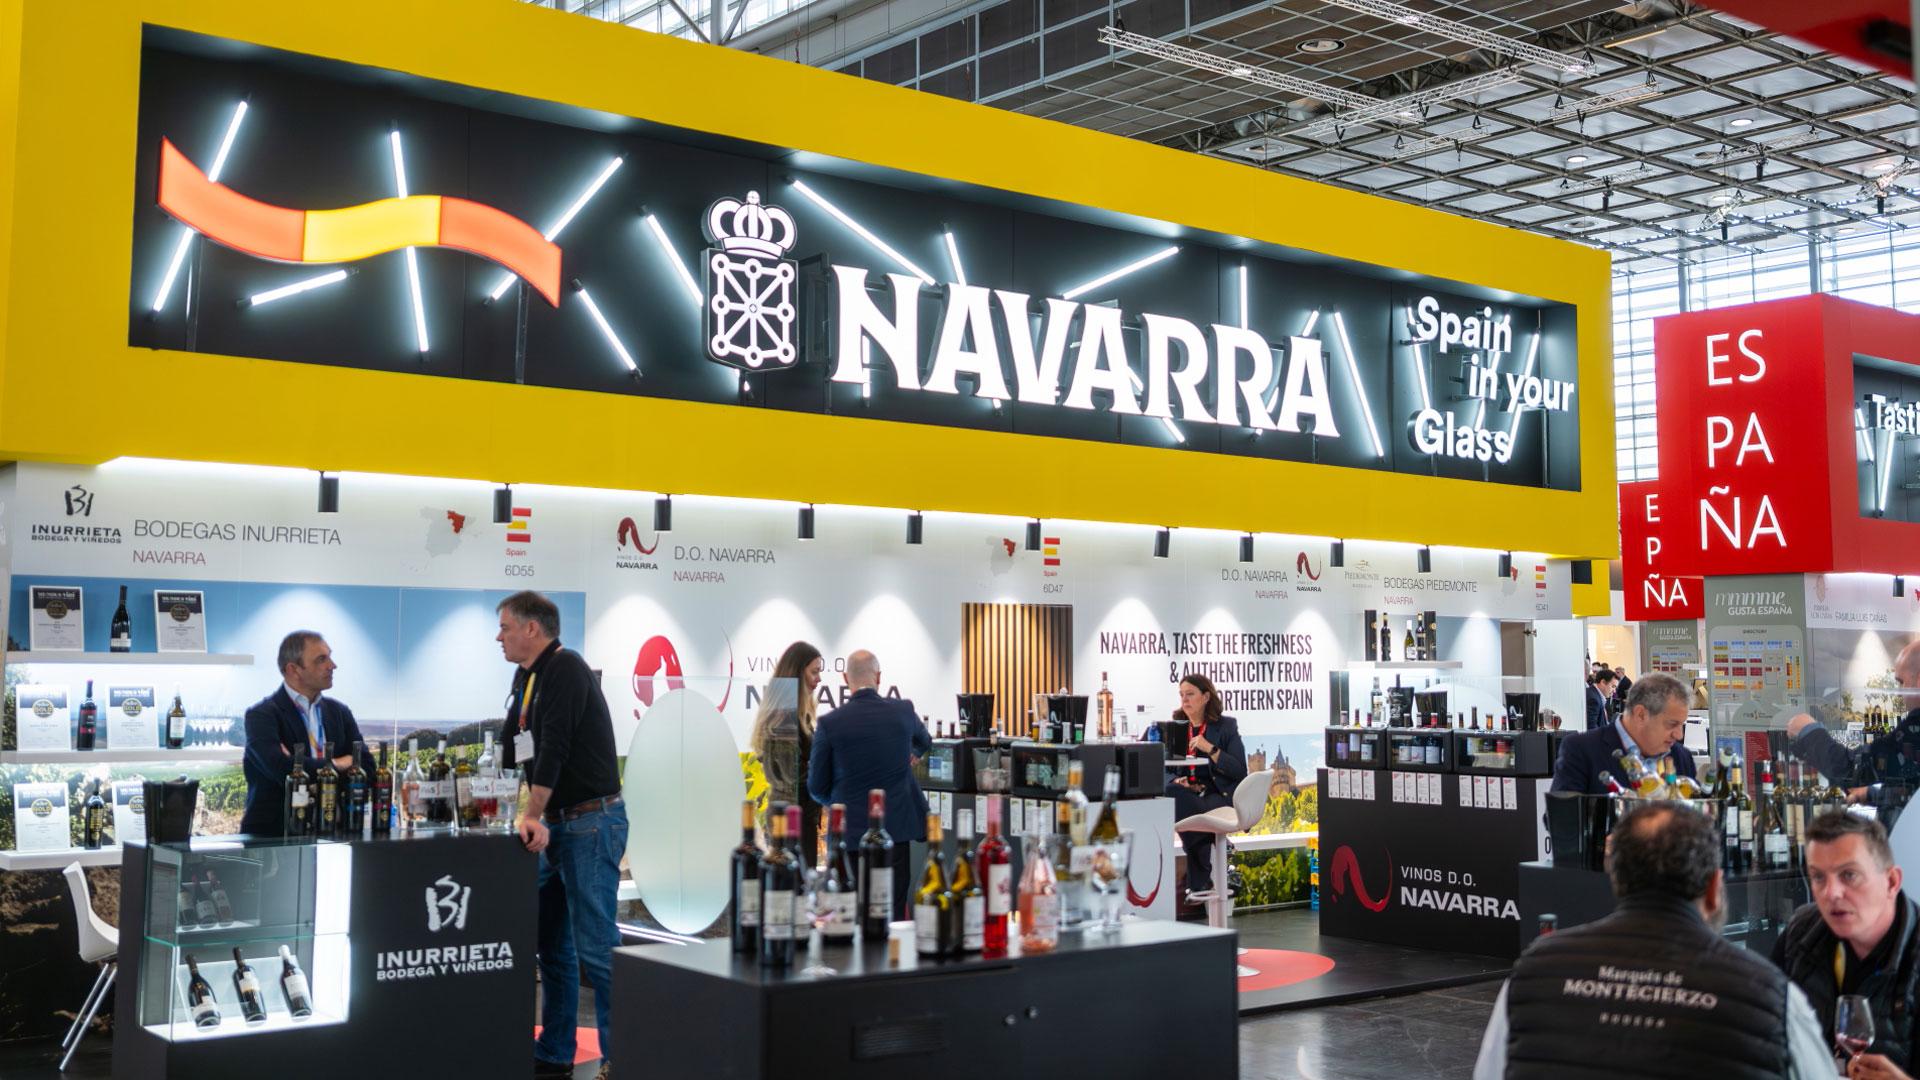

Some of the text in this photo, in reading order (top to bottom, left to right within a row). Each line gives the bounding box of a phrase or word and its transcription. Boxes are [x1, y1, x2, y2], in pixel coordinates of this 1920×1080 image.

[1416, 295, 1512, 354] Spain
[830, 264, 1340, 438] NAVARRA
[1706, 329, 1767, 386] ES
[1469, 353, 1575, 413] in your
[1414, 408, 1511, 463] Glass
[1706, 412, 1774, 468] PA
[1700, 485, 1787, 550] ÑA
[32, 524, 121, 537] INURRIETA
[134, 519, 342, 545] BODEGAS INURRIETA
[132, 550, 206, 565] NAVARRA
[505, 548, 526, 557] Spain
[674, 546, 775, 564] D.O. NAVARRA
[505, 565, 535, 577] 6D55
[616, 562, 658, 570] NAVARRA
[673, 571, 725, 582] NAVARRA
[1221, 568, 1288, 582] D.O. NAVARRA
[1255, 590, 1288, 599] NAVARRA
[1384, 577, 1477, 592] BODEGAS PIEDEMONTE
[1644, 573, 1688, 608] ÑA
[1384, 596, 1414, 605] NAVARRA
[1728, 603, 1792, 616] GUSTA ESPAÑA
[1100, 632, 1312, 656] NAVARRA, TASTE THE FRESHNESS
[1170, 661, 1179, 683] &
[1278, 662, 1312, 682] FROM
[1219, 688, 1313, 711] ORTHERN SPAIN
[1401, 866, 1477, 887] VINOS D.O.
[1401, 886, 1521, 921] NAVARRA
[377, 942, 513, 969] INURRIETA
[376, 958, 513, 981] BODEGA Y VIÑEDOS
[1563, 978, 1718, 1010] MONTECIERZO
